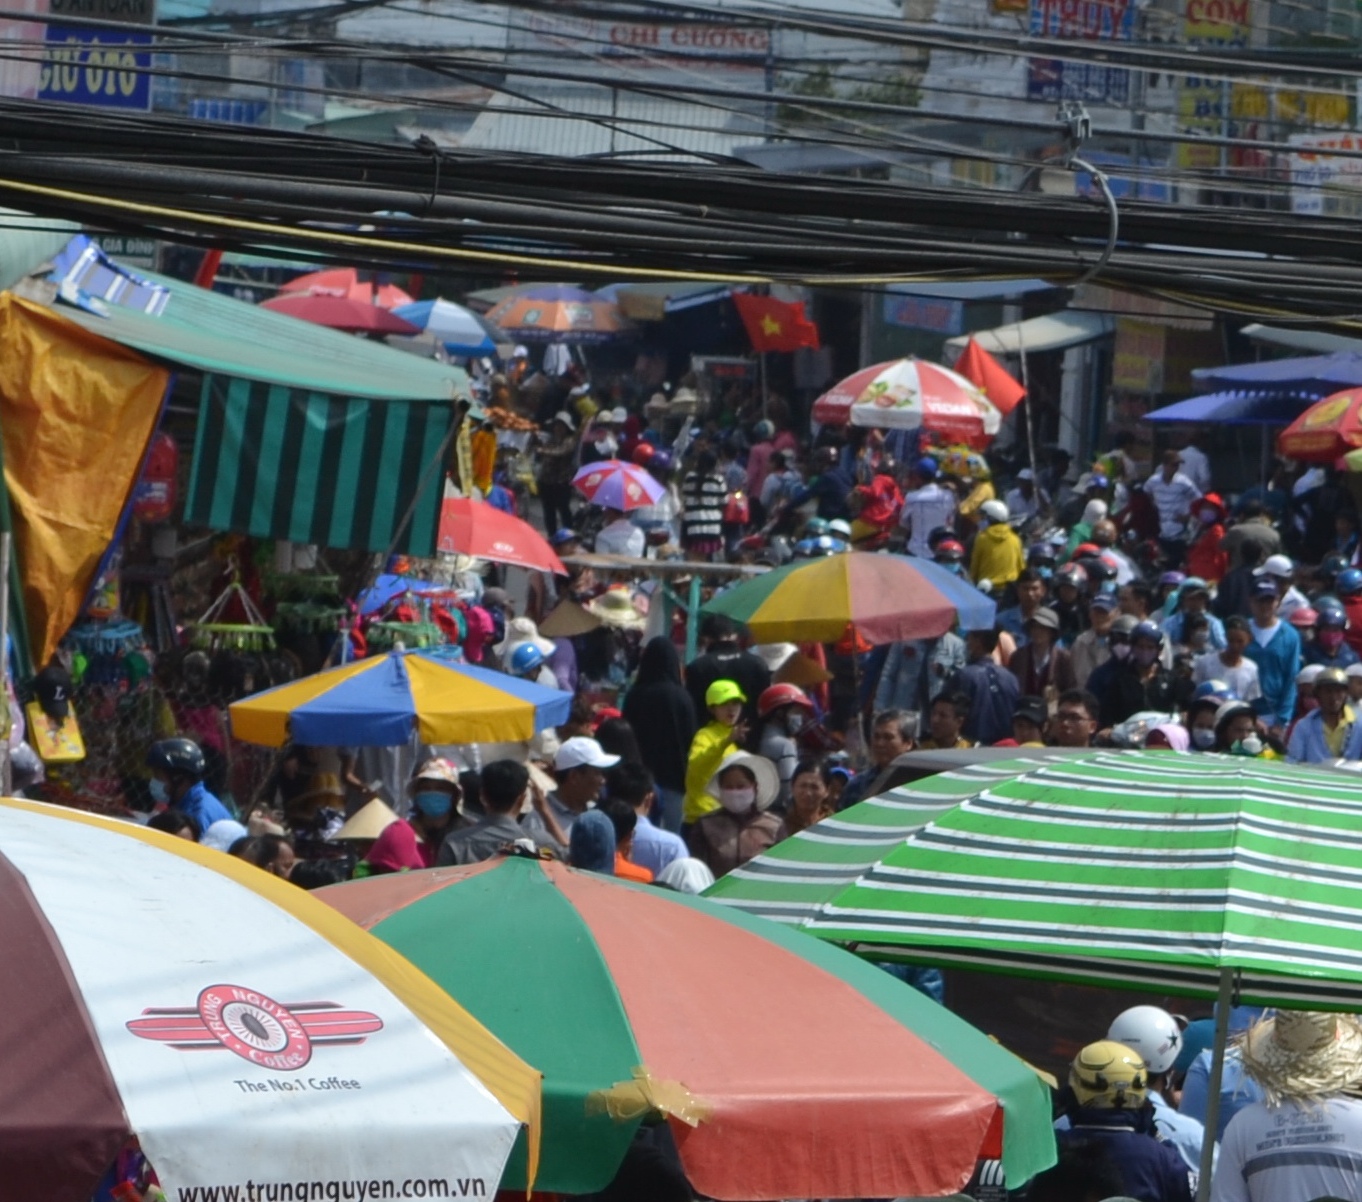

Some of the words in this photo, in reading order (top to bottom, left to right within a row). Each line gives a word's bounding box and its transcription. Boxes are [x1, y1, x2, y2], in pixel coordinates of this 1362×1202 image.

[203, 993, 232, 1042] TRUNG
[231, 988, 305, 1040] NGUYEN
[248, 1049, 305, 1069] Coffee
[233, 1079, 269, 1094] The
[308, 1076, 362, 1091] Coffee
